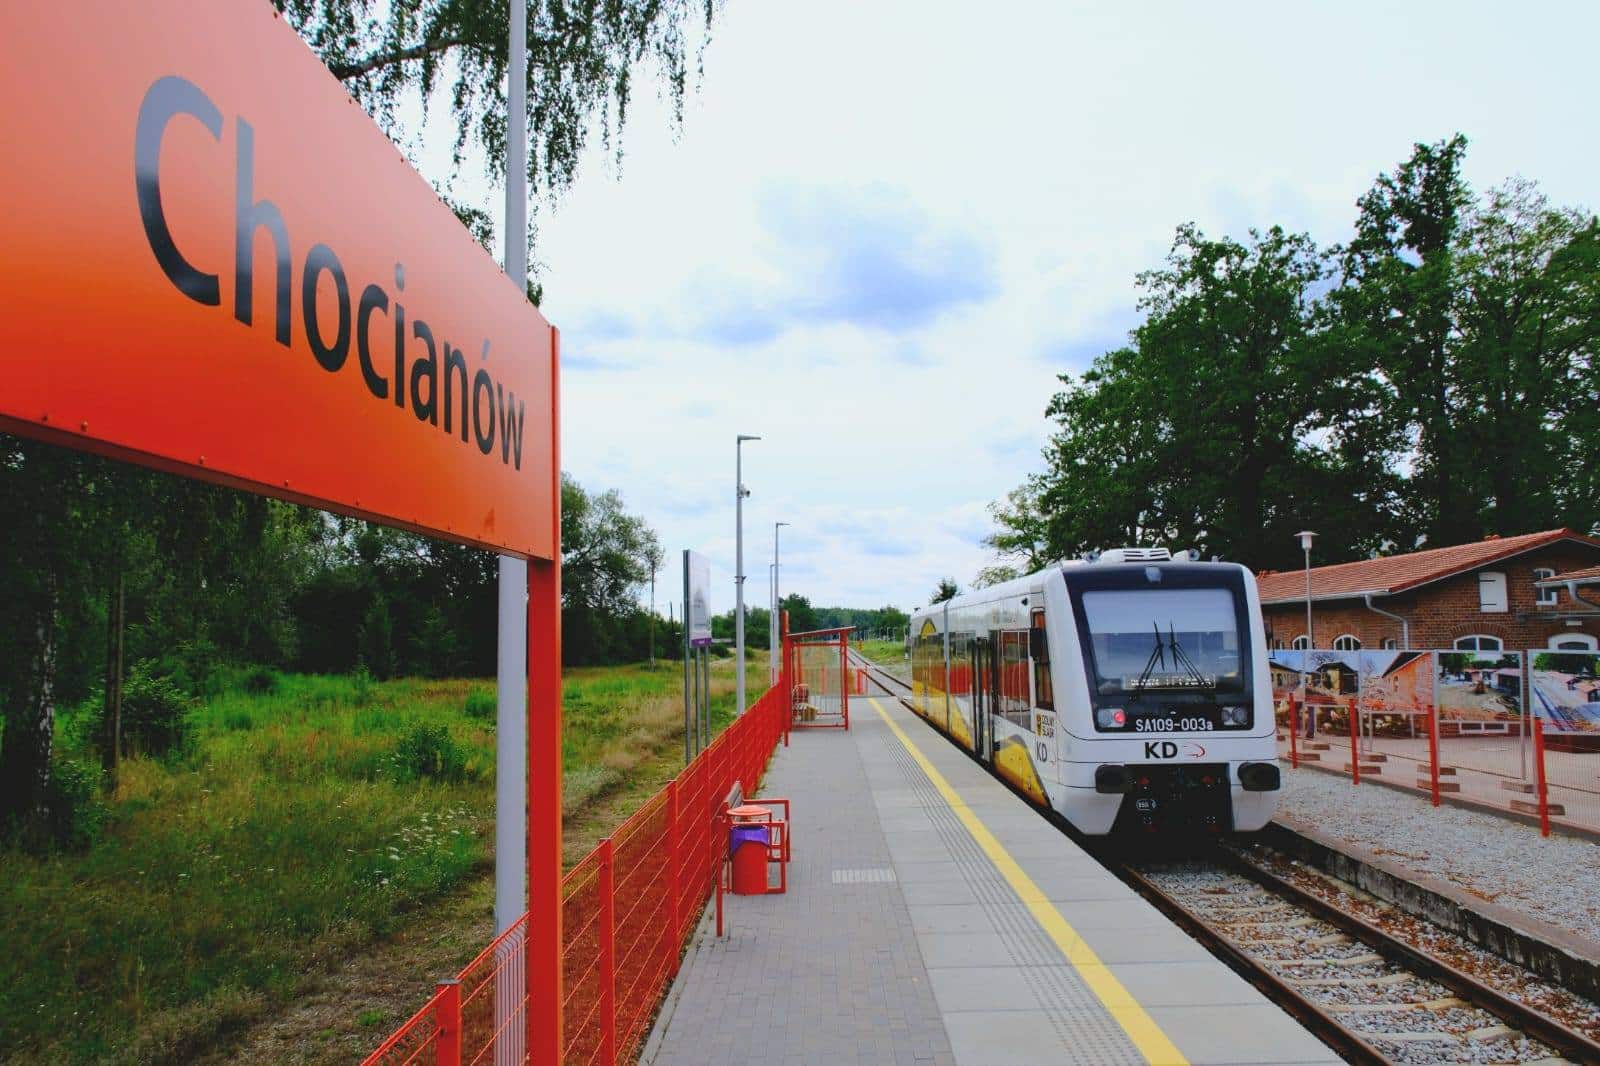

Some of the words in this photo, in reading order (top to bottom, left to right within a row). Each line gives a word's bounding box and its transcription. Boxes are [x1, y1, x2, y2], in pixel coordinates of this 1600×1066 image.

[134, 75, 526, 471] Chocianów
[1136, 718, 1213, 731] SA109-003a
[1036, 741, 1048, 762] KD
[1144, 741, 1178, 759] KD
